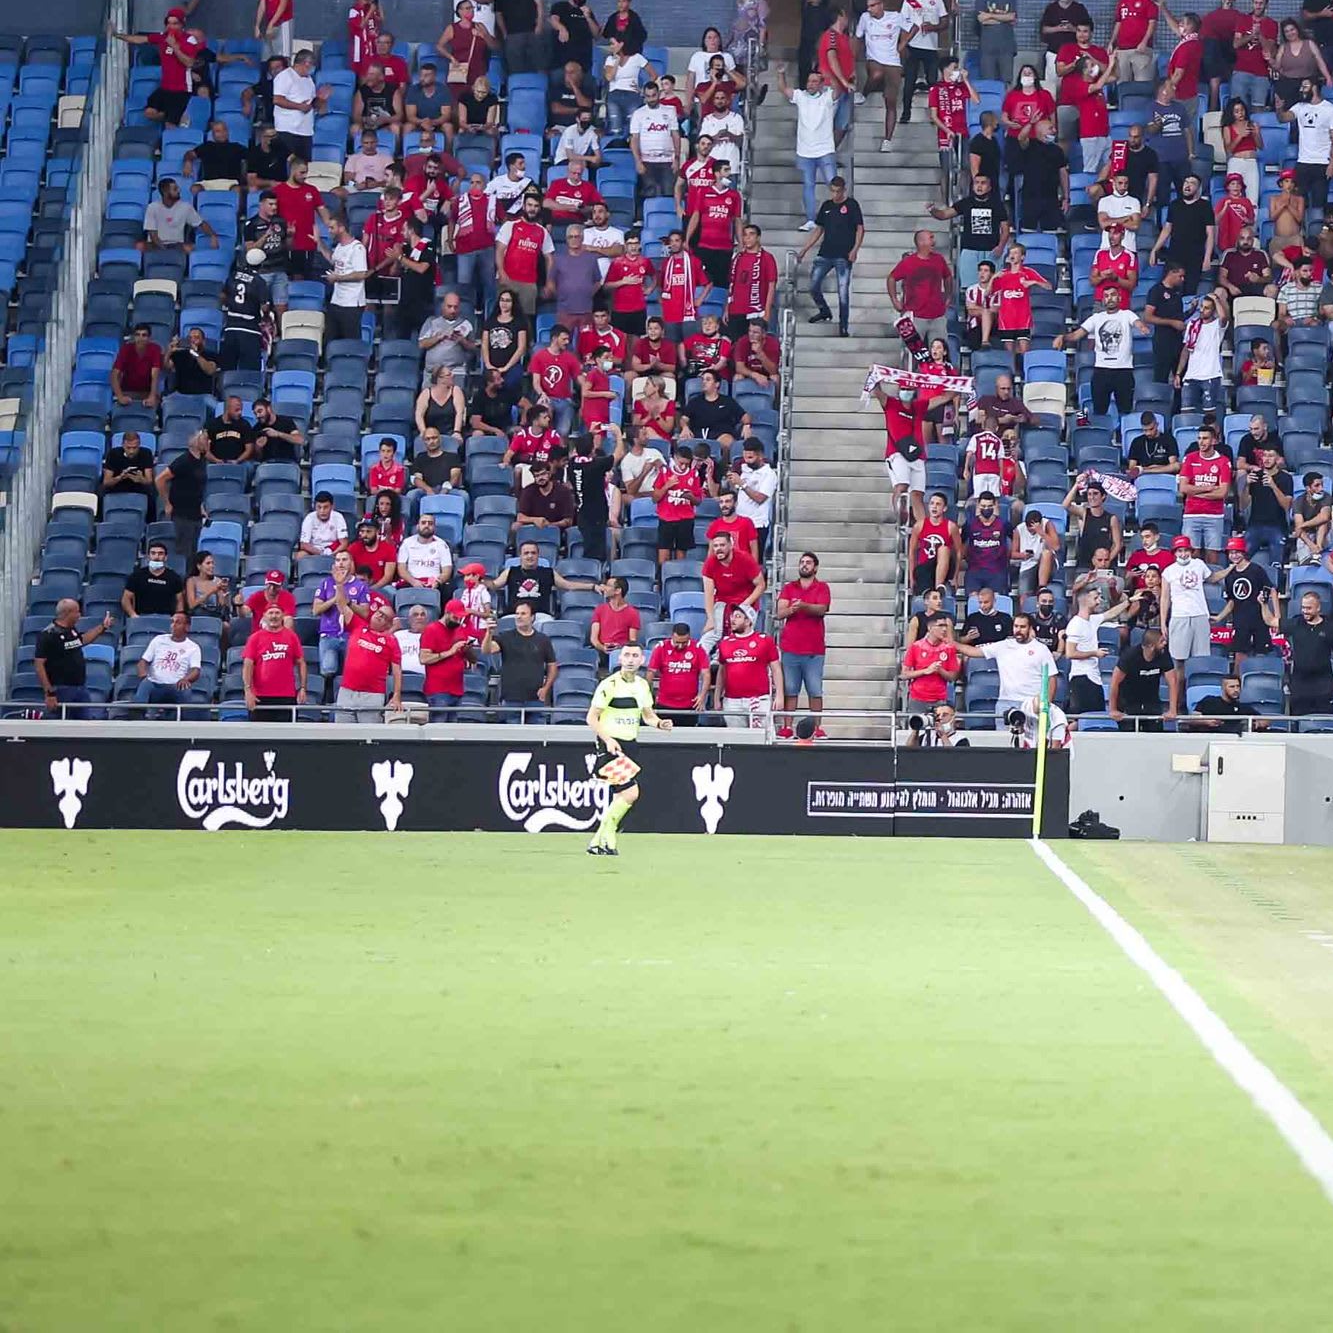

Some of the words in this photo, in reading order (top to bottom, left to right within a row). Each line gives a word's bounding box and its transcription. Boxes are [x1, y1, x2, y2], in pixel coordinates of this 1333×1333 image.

[980, 442, 996, 459] 14
[177, 750, 290, 828] Carlsberg
[499, 753, 611, 831] Carlsberg
[811, 789, 845, 808] מופרזת.
[912, 789, 937, 811] מומלץ
[946, 790, 978, 808] אלכוהול
[981, 790, 999, 809] מכיל
[1001, 791, 1032, 809] אזהרה:
